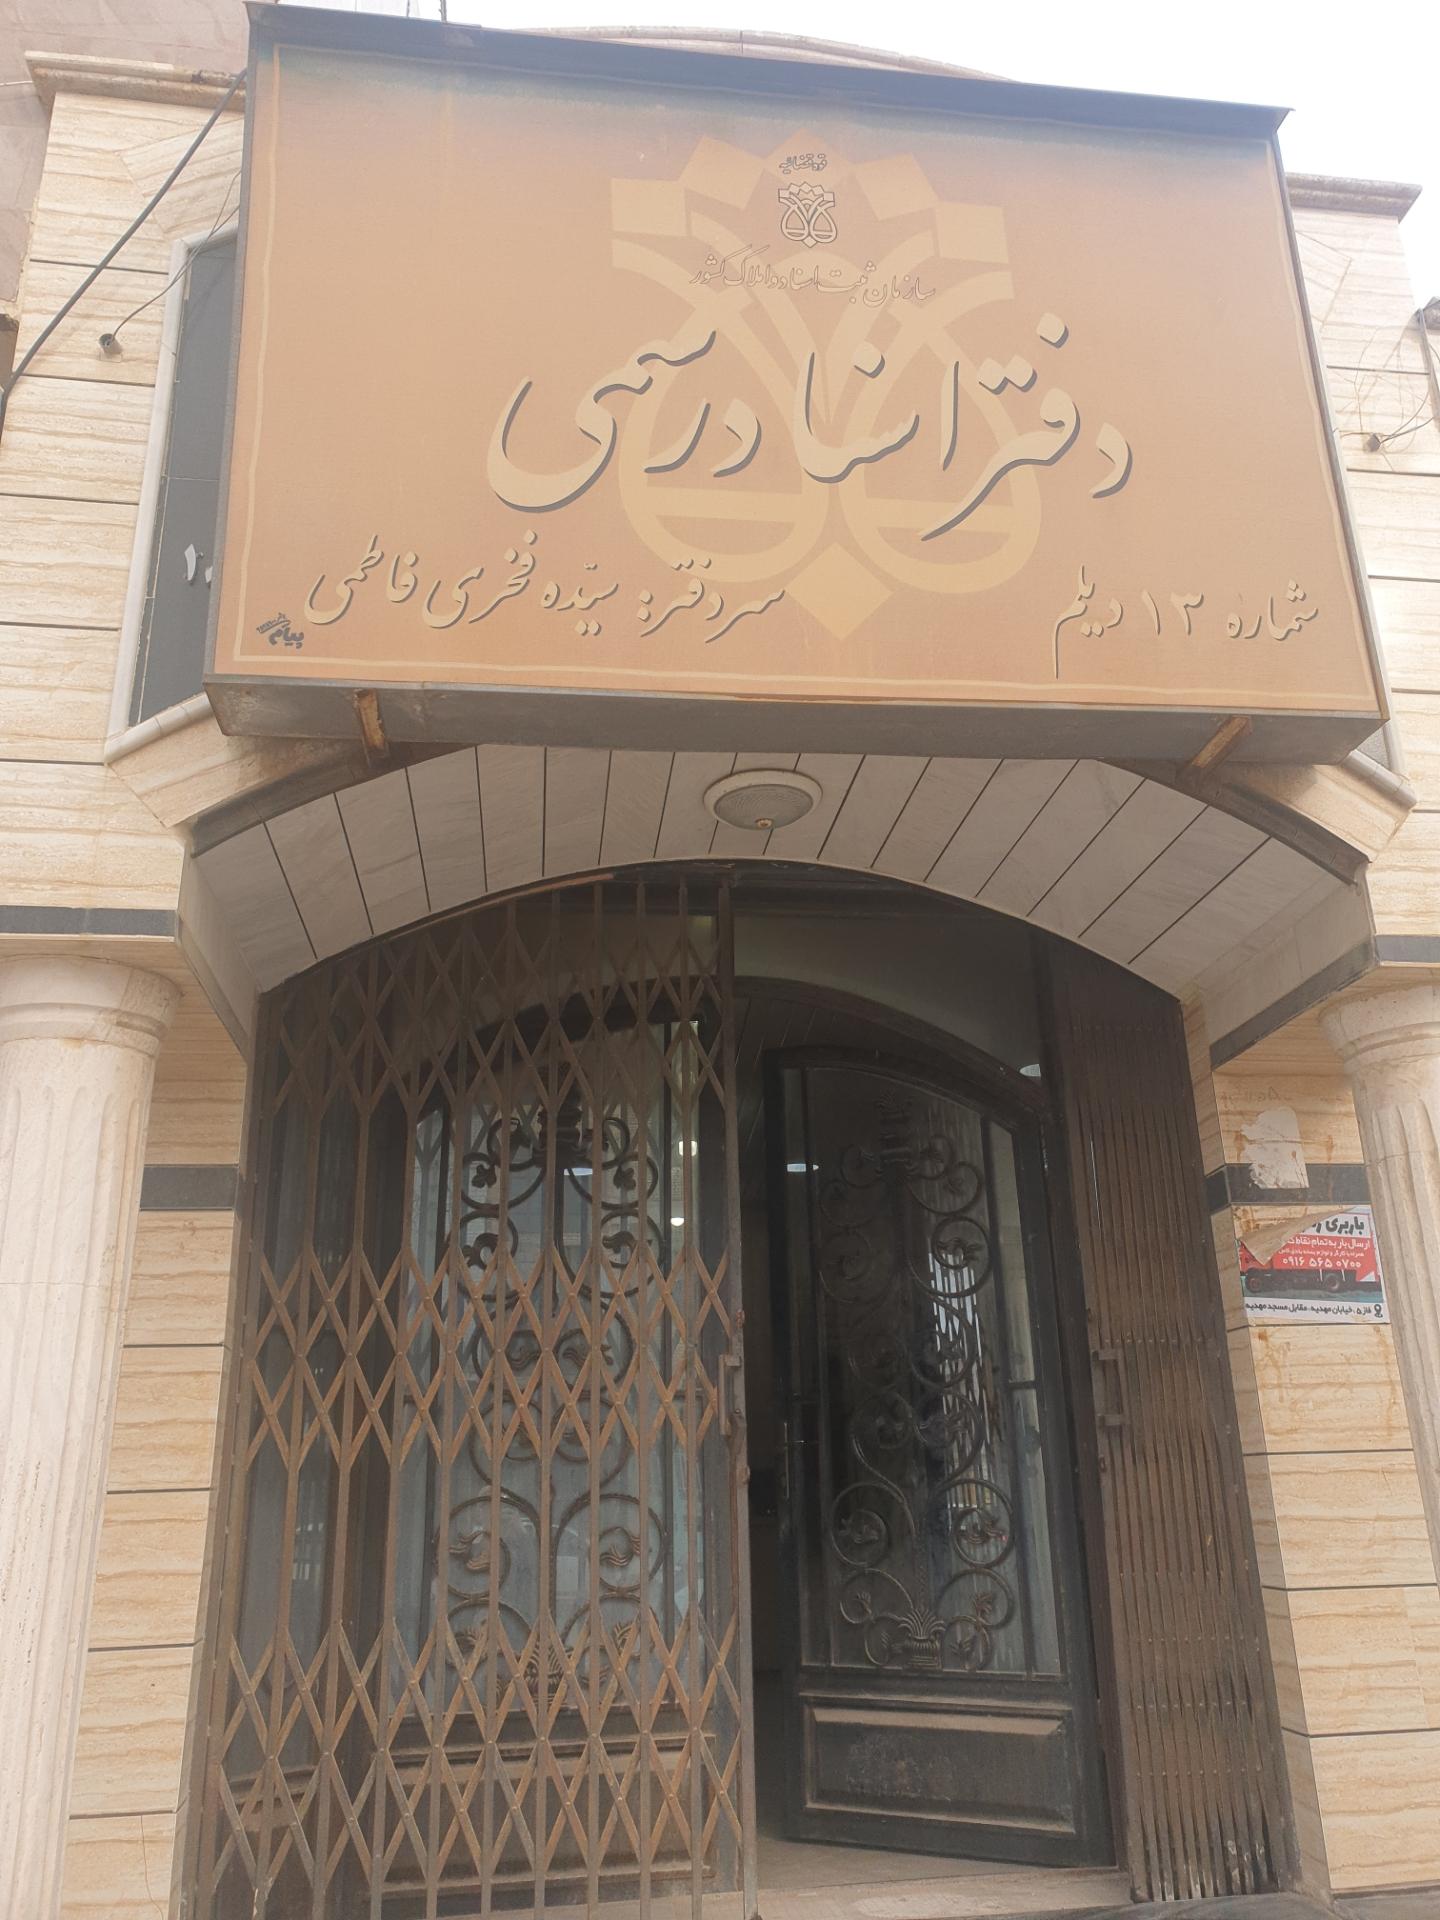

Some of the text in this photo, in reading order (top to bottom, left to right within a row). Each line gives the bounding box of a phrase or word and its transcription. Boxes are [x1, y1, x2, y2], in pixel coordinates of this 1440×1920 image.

[688, 243, 753, 286] کشور
[723, 244, 771, 288] املاک
[778, 265, 819, 290] اسناد
[817, 260, 877, 304] ثبت
[863, 275, 937, 308] سازمان
[487, 312, 1133, 541] دفتر اسناد رسمی
[304, 533, 418, 626] فاطمی
[422, 529, 538, 629] فخری
[1051, 565, 1124, 681] دیلم
[1226, 578, 1319, 641] شماره
[1312, 1237, 1329, 1248] تمام
[1325, 1216, 1364, 1235] باربری
[1348, 1239, 1371, 1250] ارسال
[1282, 1256, 1361, 1269] ۰۹۱۶ ۵۶۵ ۰۷۰۰
[1267, 1304, 1288, 1312] مسجد
[1332, 1305, 1352, 1315] خیابان
